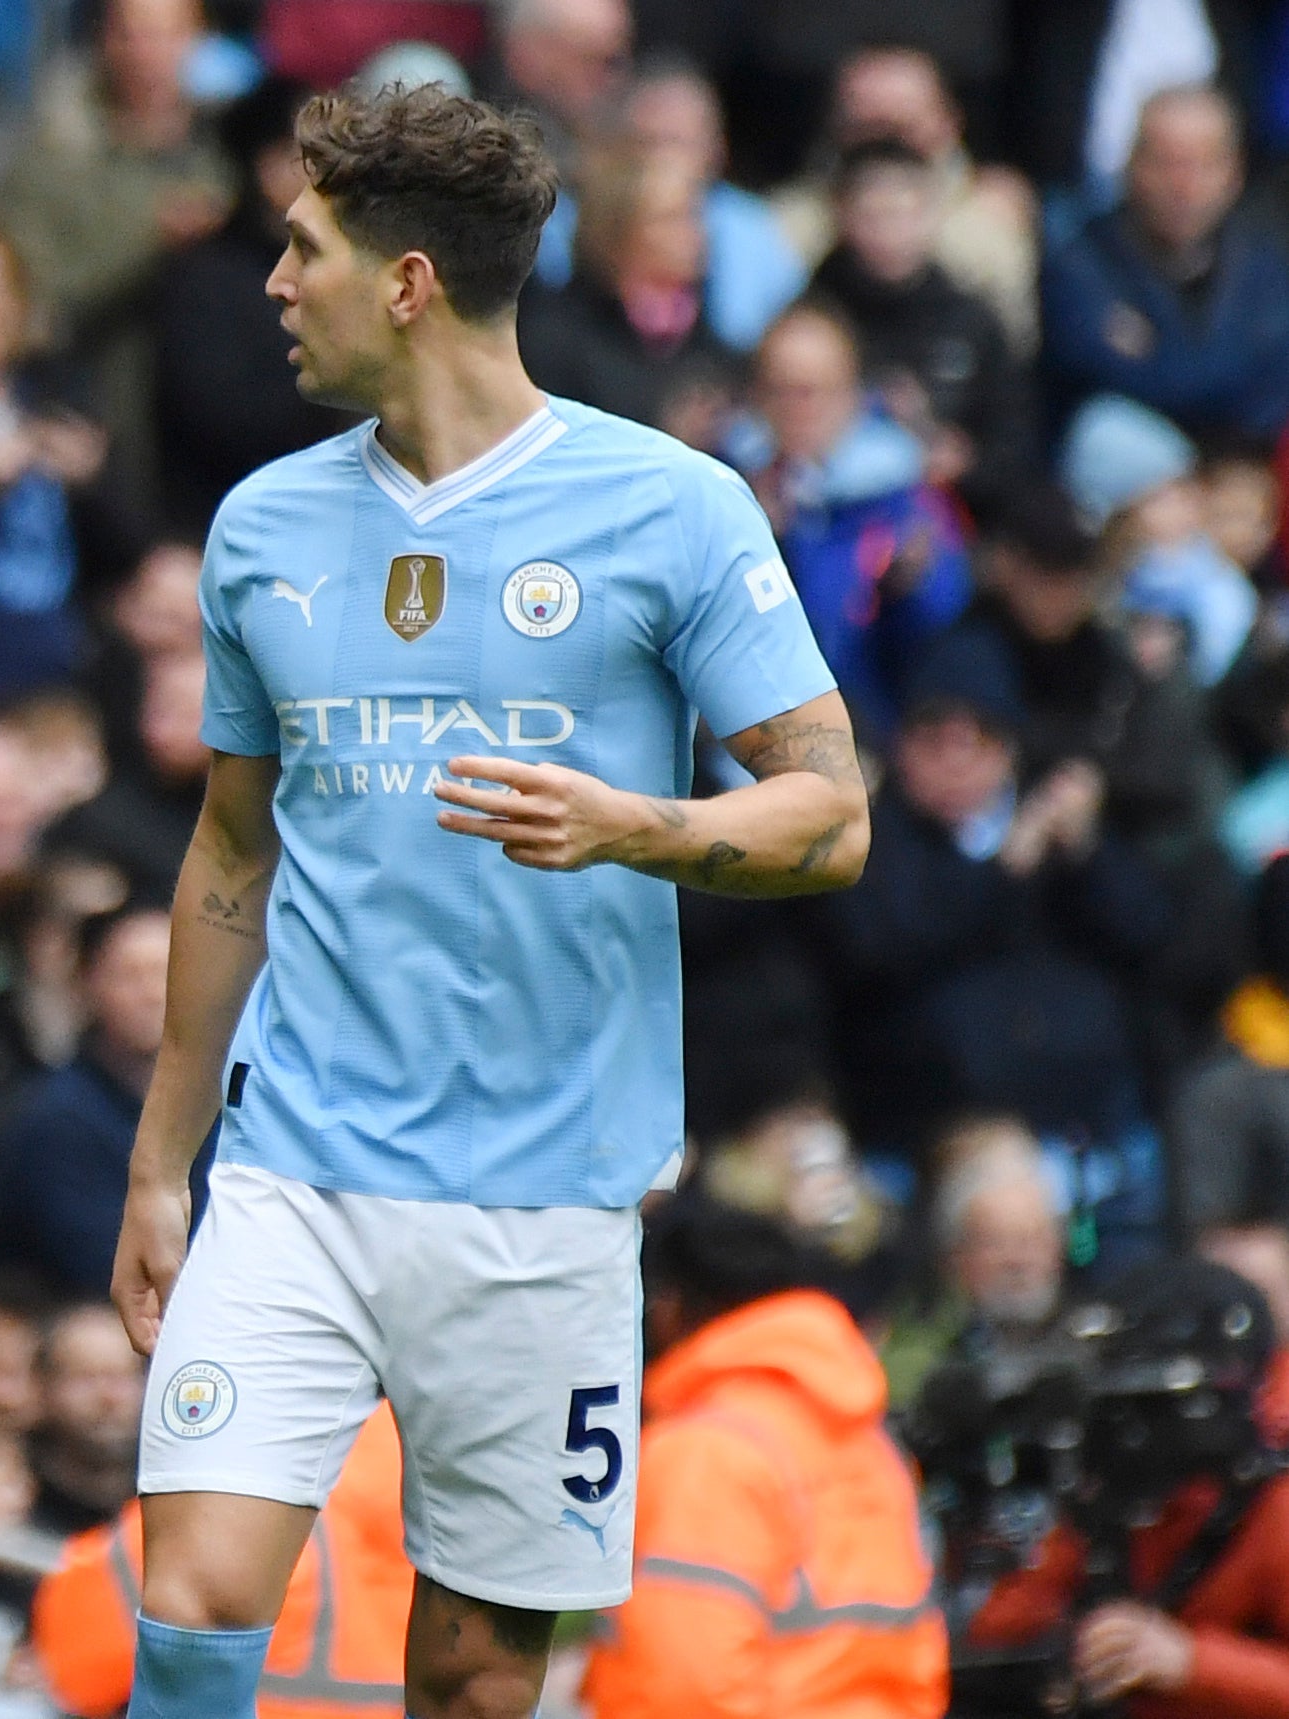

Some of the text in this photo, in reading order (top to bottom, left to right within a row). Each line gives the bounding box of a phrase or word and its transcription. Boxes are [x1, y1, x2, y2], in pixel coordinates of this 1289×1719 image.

[511, 566, 574, 589] MANCHESTER
[399, 610, 427, 621] FIFA
[528, 625, 551, 635] CITY
[276, 698, 575, 746] ETIHAD
[314, 763, 512, 796] AIRWA
[170, 1366, 229, 1392] MANCHESTER
[181, 1426, 204, 1435] CITY
[562, 1384, 622, 1504] 5
